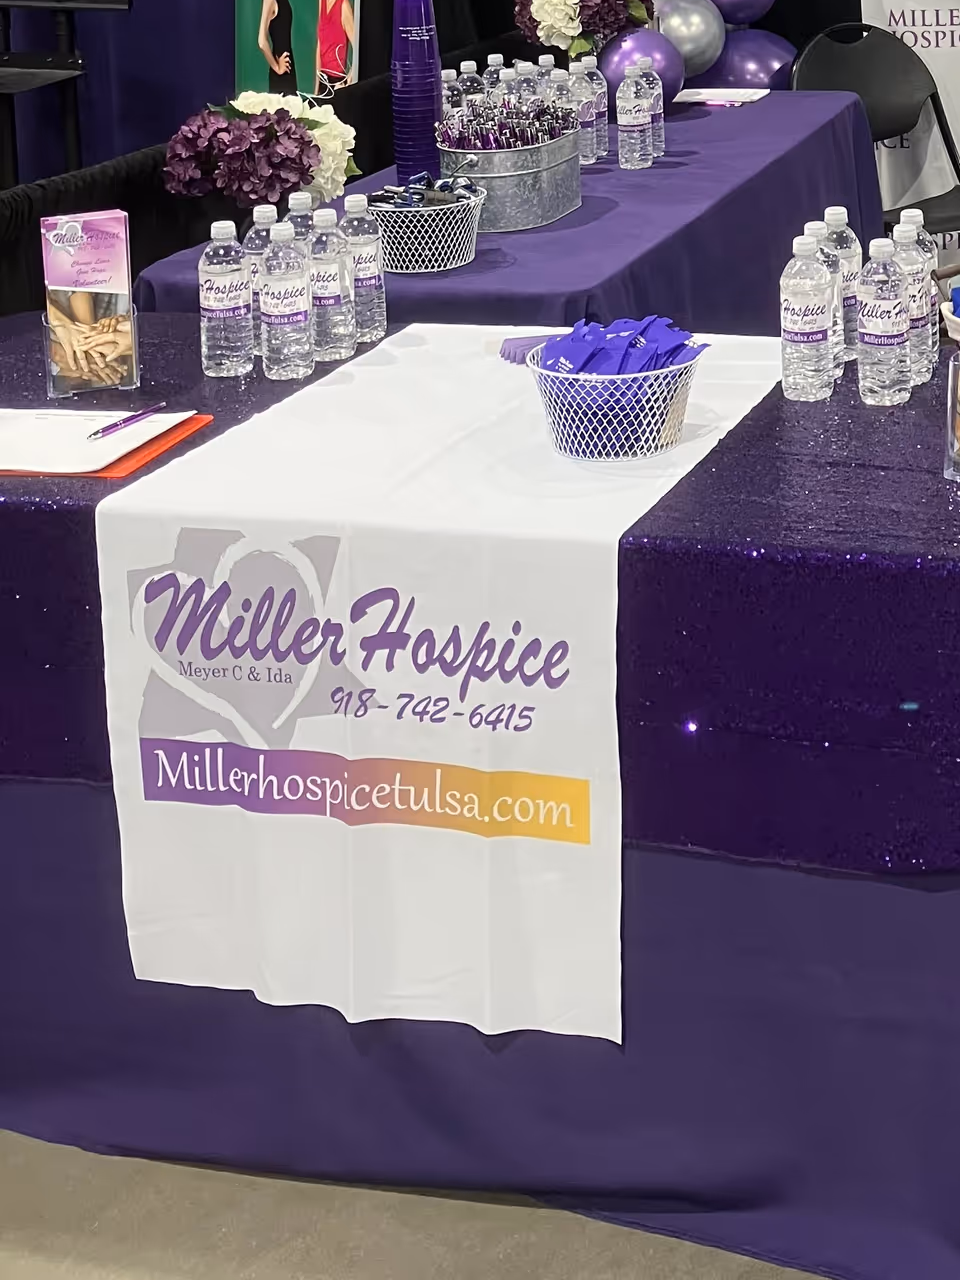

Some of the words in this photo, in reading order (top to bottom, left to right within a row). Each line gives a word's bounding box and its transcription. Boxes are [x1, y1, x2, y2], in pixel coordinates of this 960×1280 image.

[204, 279, 250, 298] Hospice
[263, 283, 306, 304] Hospice
[783, 299, 827, 322] Hospice
[144, 572, 346, 667] Miller
[350, 586, 571, 704] Hospice
[178, 660, 230, 682] Meyer
[231, 663, 243, 681] C
[247, 666, 262, 683] &
[266, 666, 293, 685] Ida
[330, 686, 536, 733] 918-742-6415
[153, 748, 575, 829] Millerhospicetulsa.com
